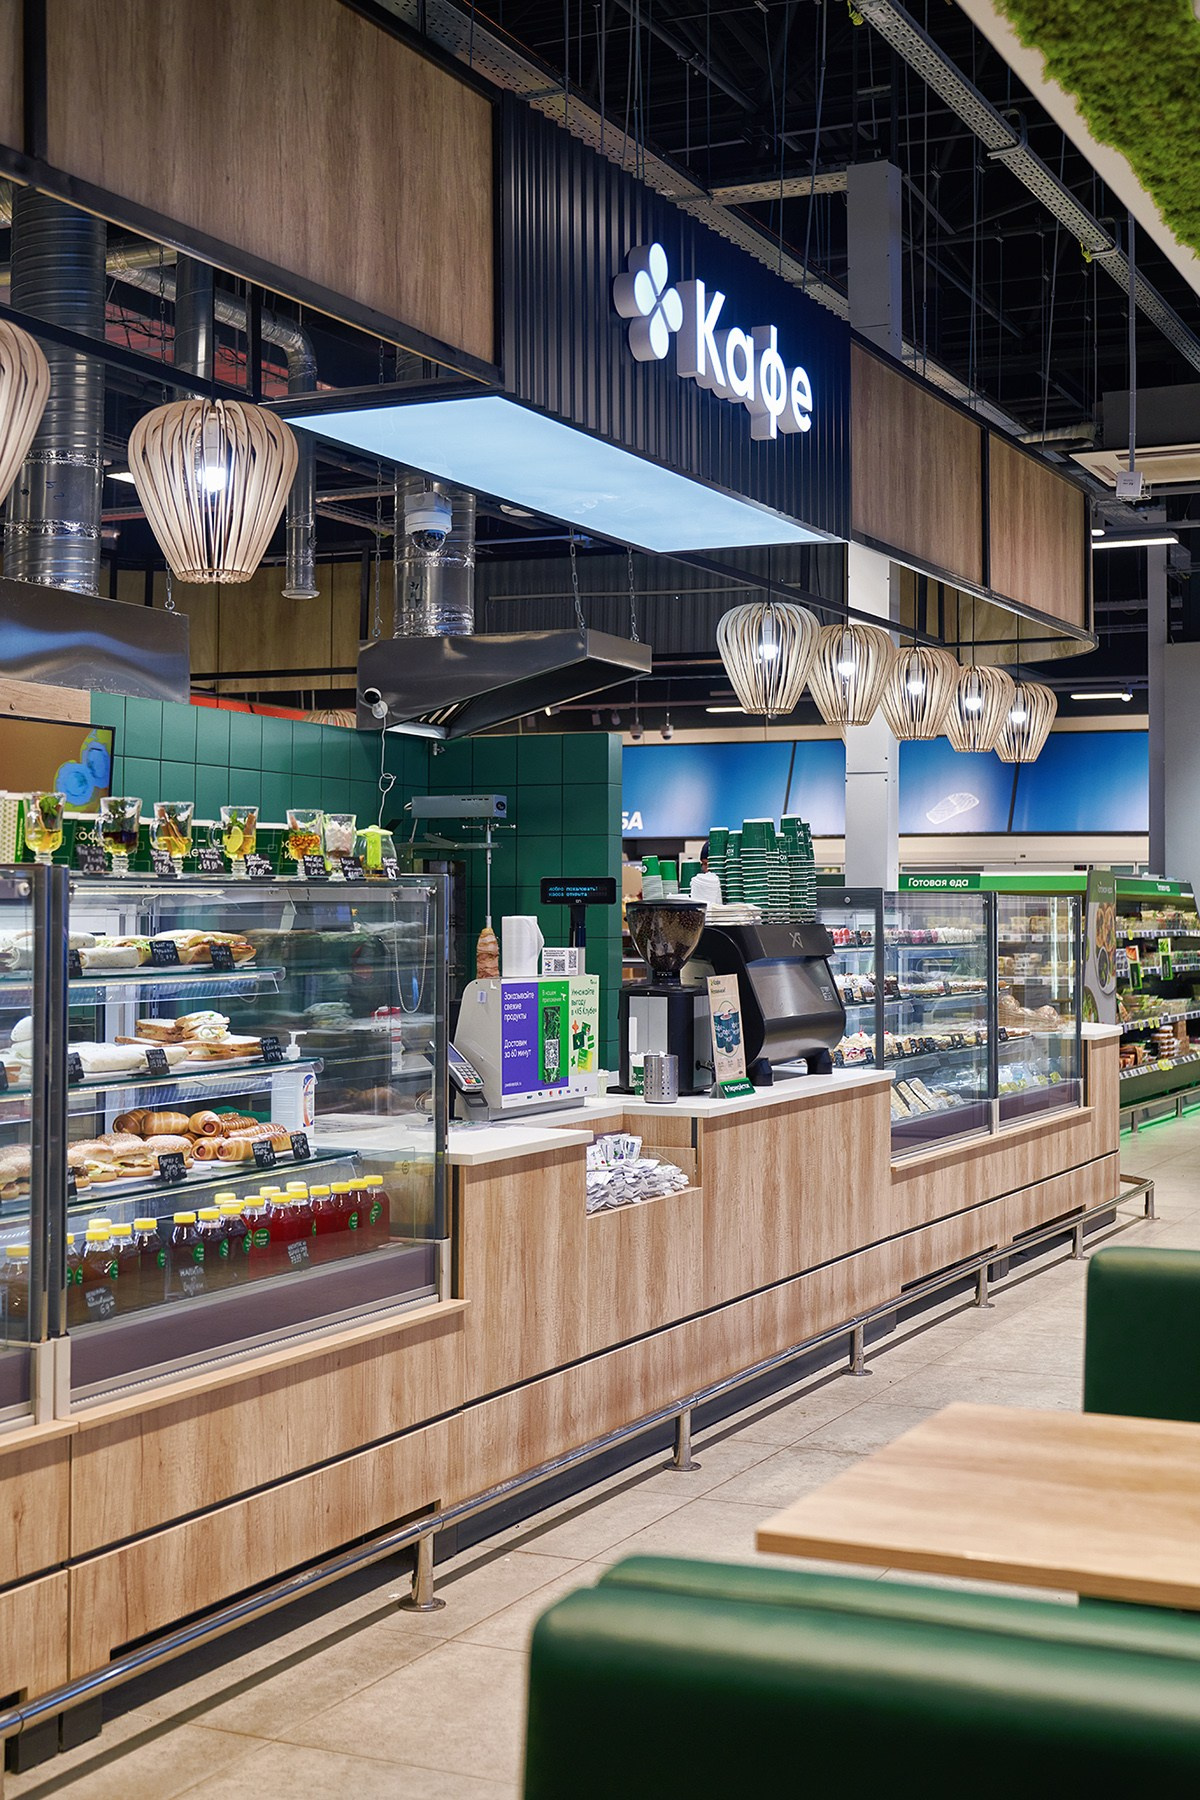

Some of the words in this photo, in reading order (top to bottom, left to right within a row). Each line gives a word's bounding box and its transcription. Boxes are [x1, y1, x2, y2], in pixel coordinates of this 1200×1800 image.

[694, 278, 814, 441] Кафе
[908, 877, 947, 887] Готовая
[949, 879, 969, 888] еда
[504, 991, 535, 1001] Заказывайте
[504, 1002, 522, 1011] свежие
[504, 1012, 528, 1023] продукты
[504, 1039, 528, 1049] Доставим
[518, 1048, 532, 1058] минут
